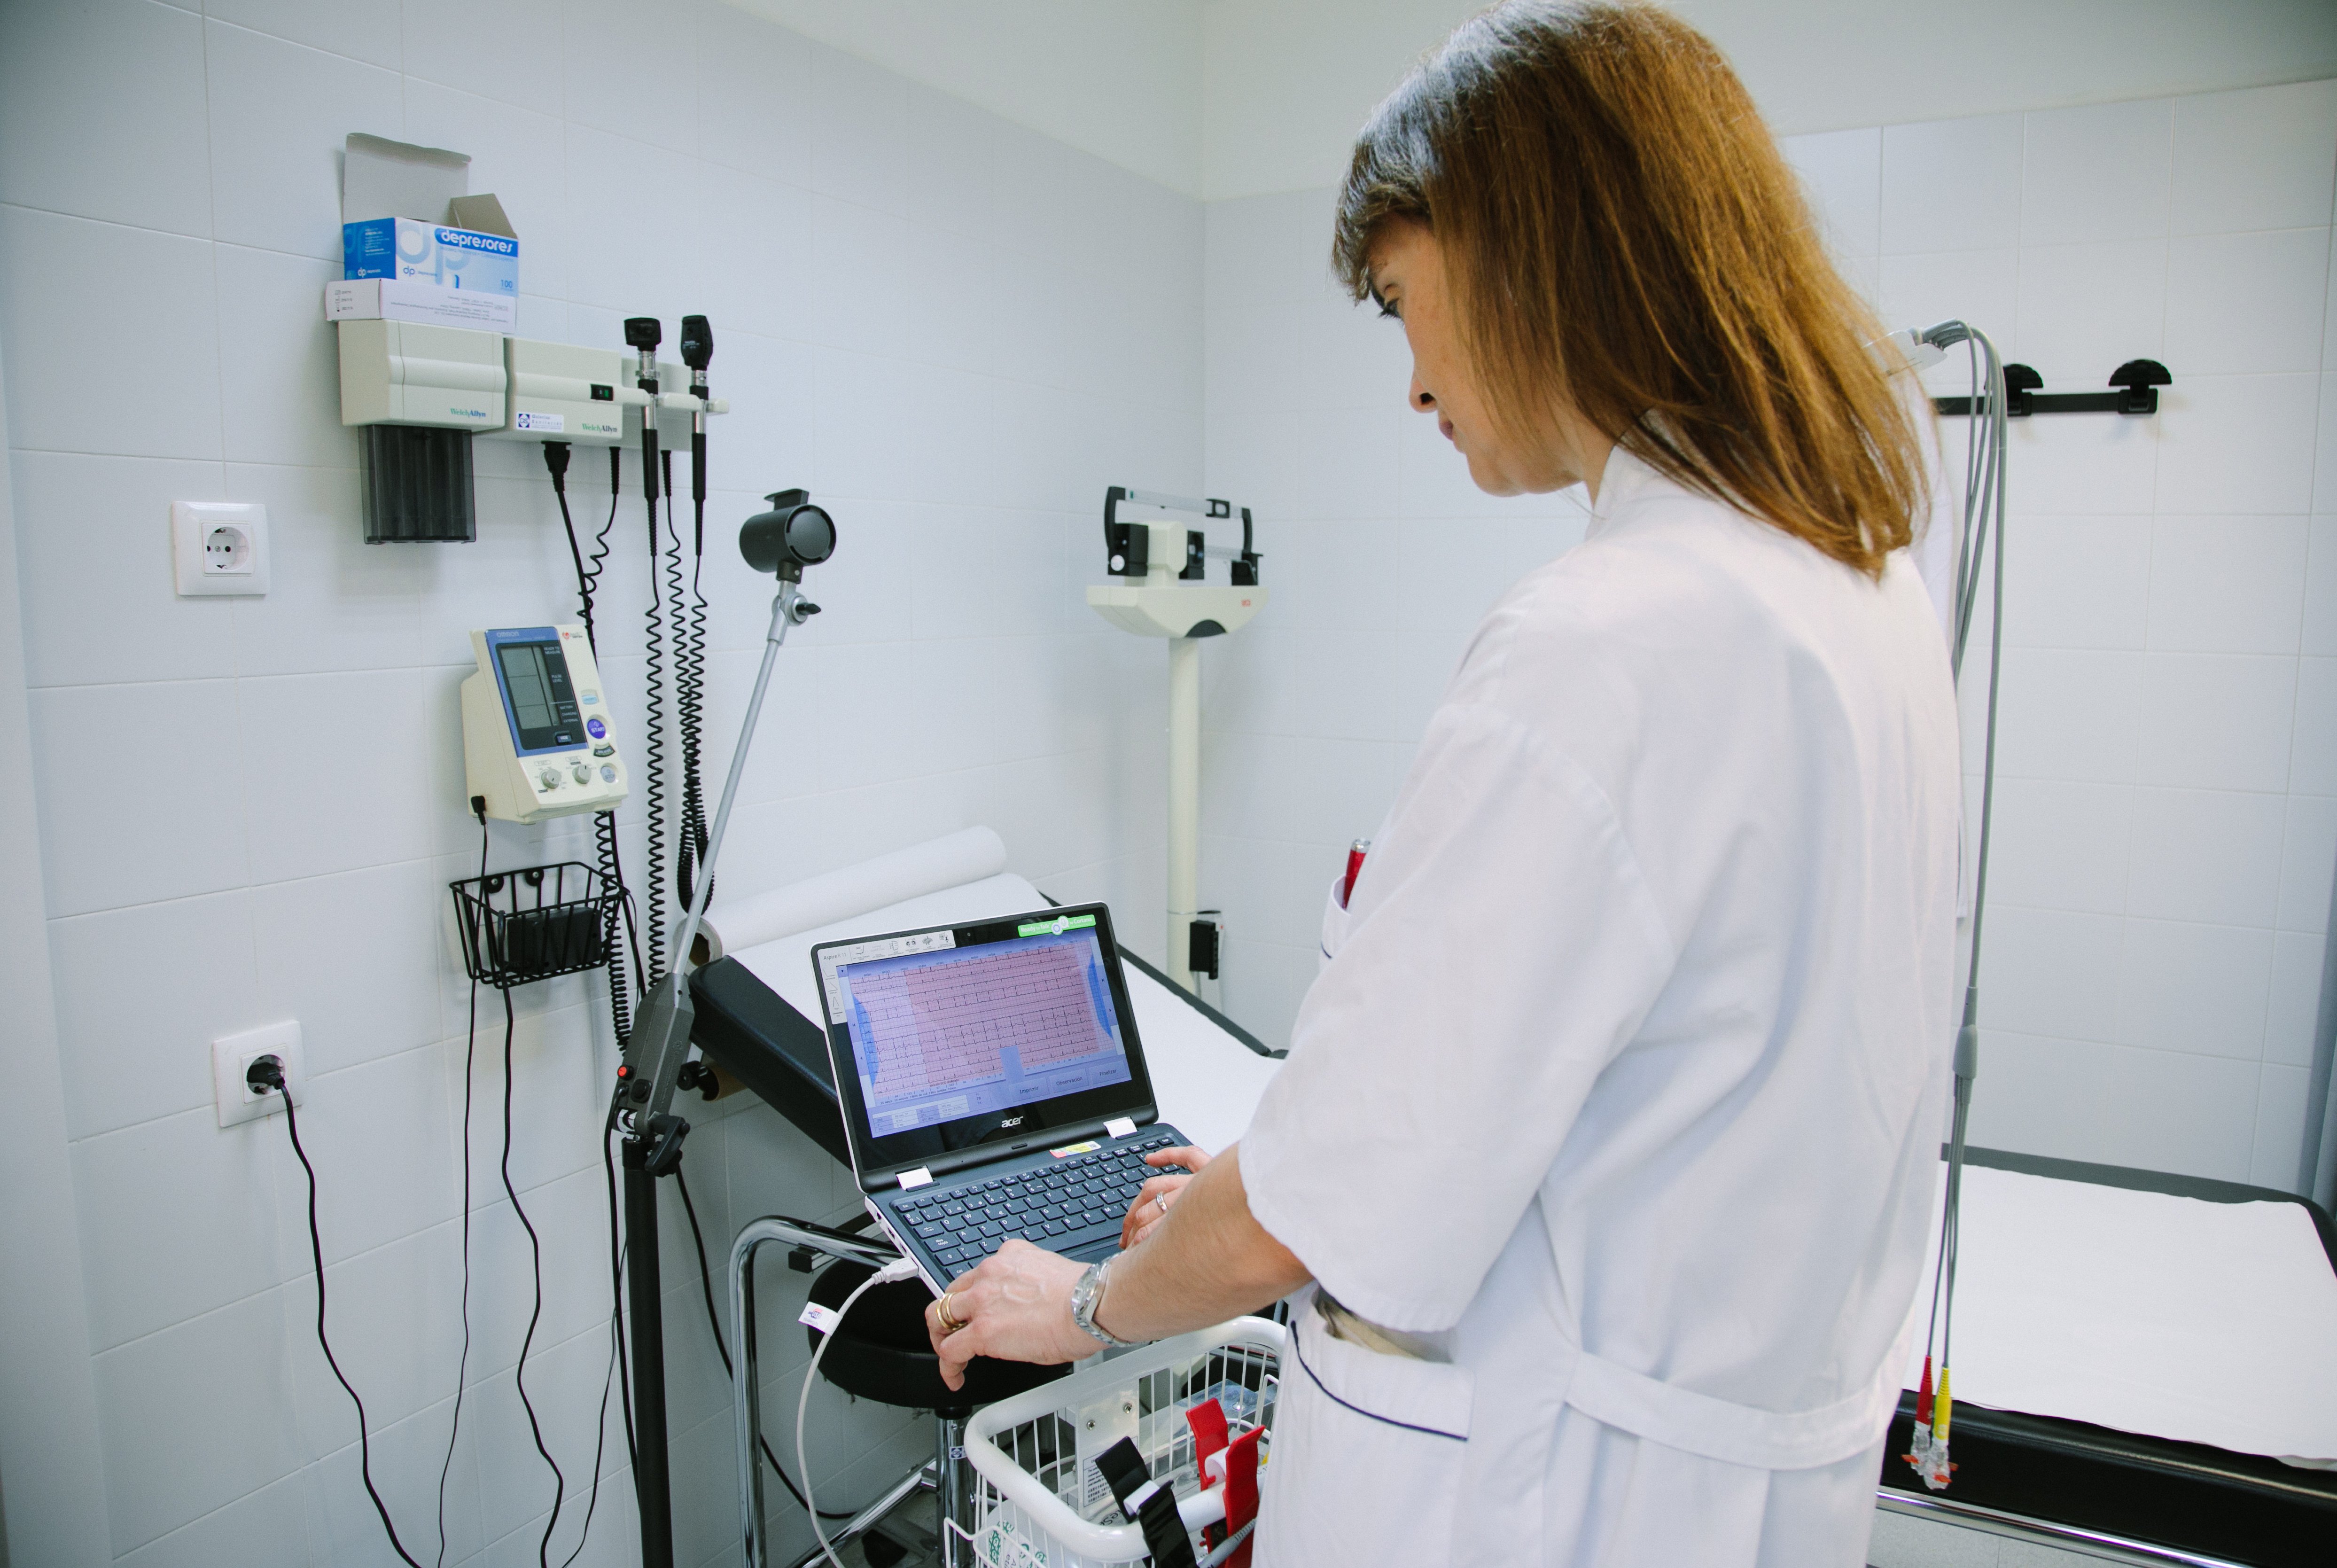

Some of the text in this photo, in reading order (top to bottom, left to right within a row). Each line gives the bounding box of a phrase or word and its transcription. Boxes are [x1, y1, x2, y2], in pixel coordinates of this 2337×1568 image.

[441, 229, 513, 253] depresores
[358, 266, 366, 278] dp
[403, 266, 415, 276] dp
[501, 279, 513, 289] 100
[1056, 1076, 1083, 1086] Observación
[1019, 1086, 1039, 1094] Imprimir
[1001, 1116, 1023, 1128] acer
